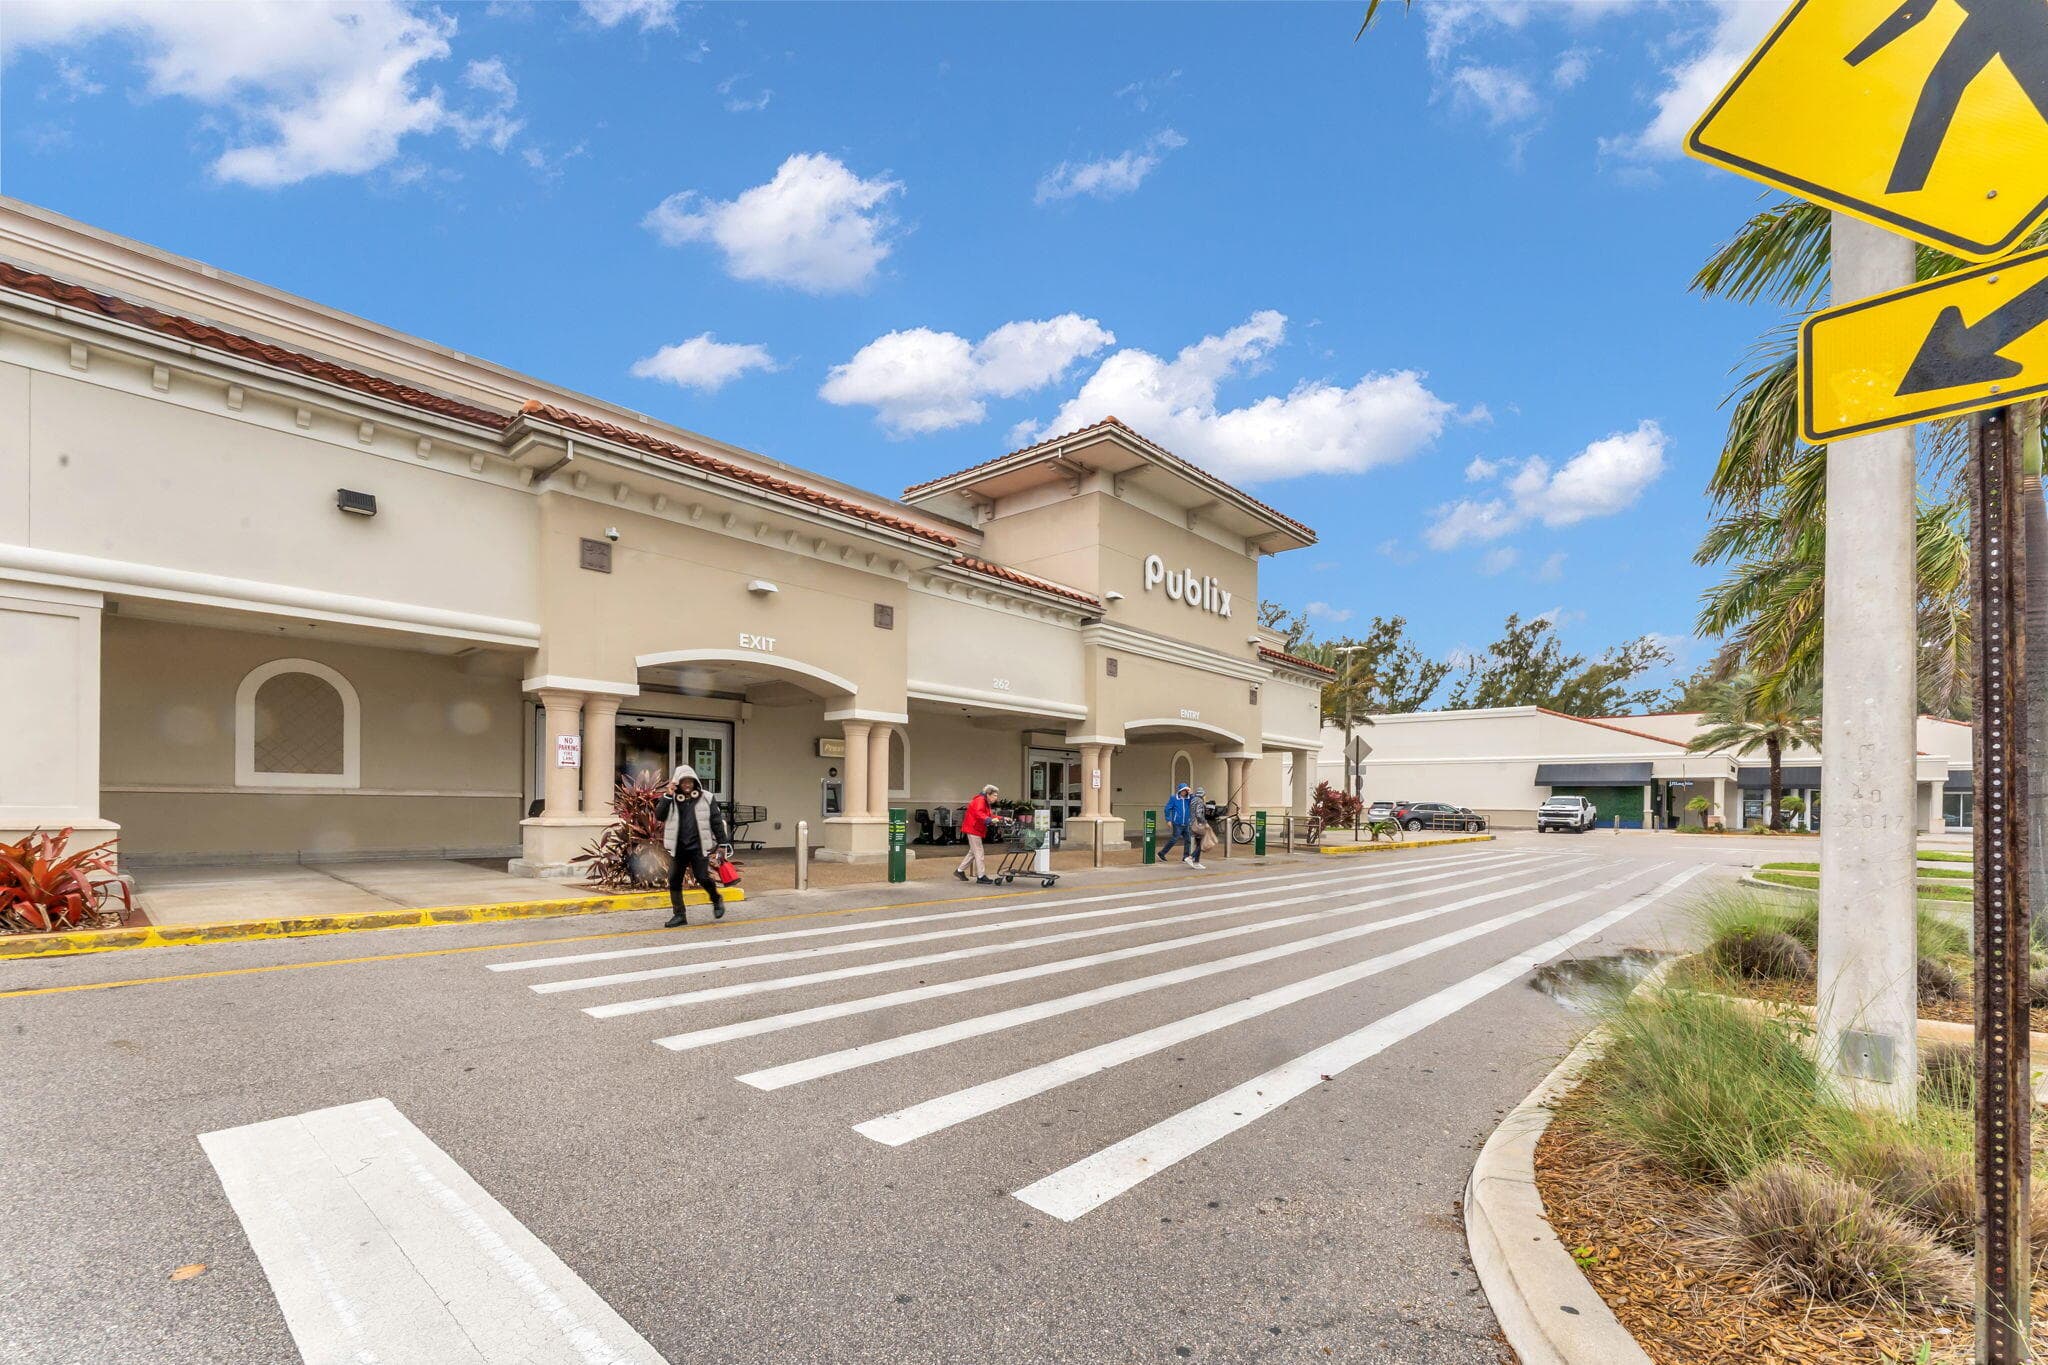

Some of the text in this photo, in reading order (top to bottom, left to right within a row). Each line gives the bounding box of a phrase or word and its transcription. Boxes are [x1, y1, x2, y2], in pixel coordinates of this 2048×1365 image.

[1144, 554, 1231, 618] Publix
[739, 632, 777, 652] EXIT
[993, 678, 1010, 690] 262
[1180, 709, 1200, 720] ENTRY
[564, 737, 574, 745] NO
[558, 744, 580, 752] PARKING
